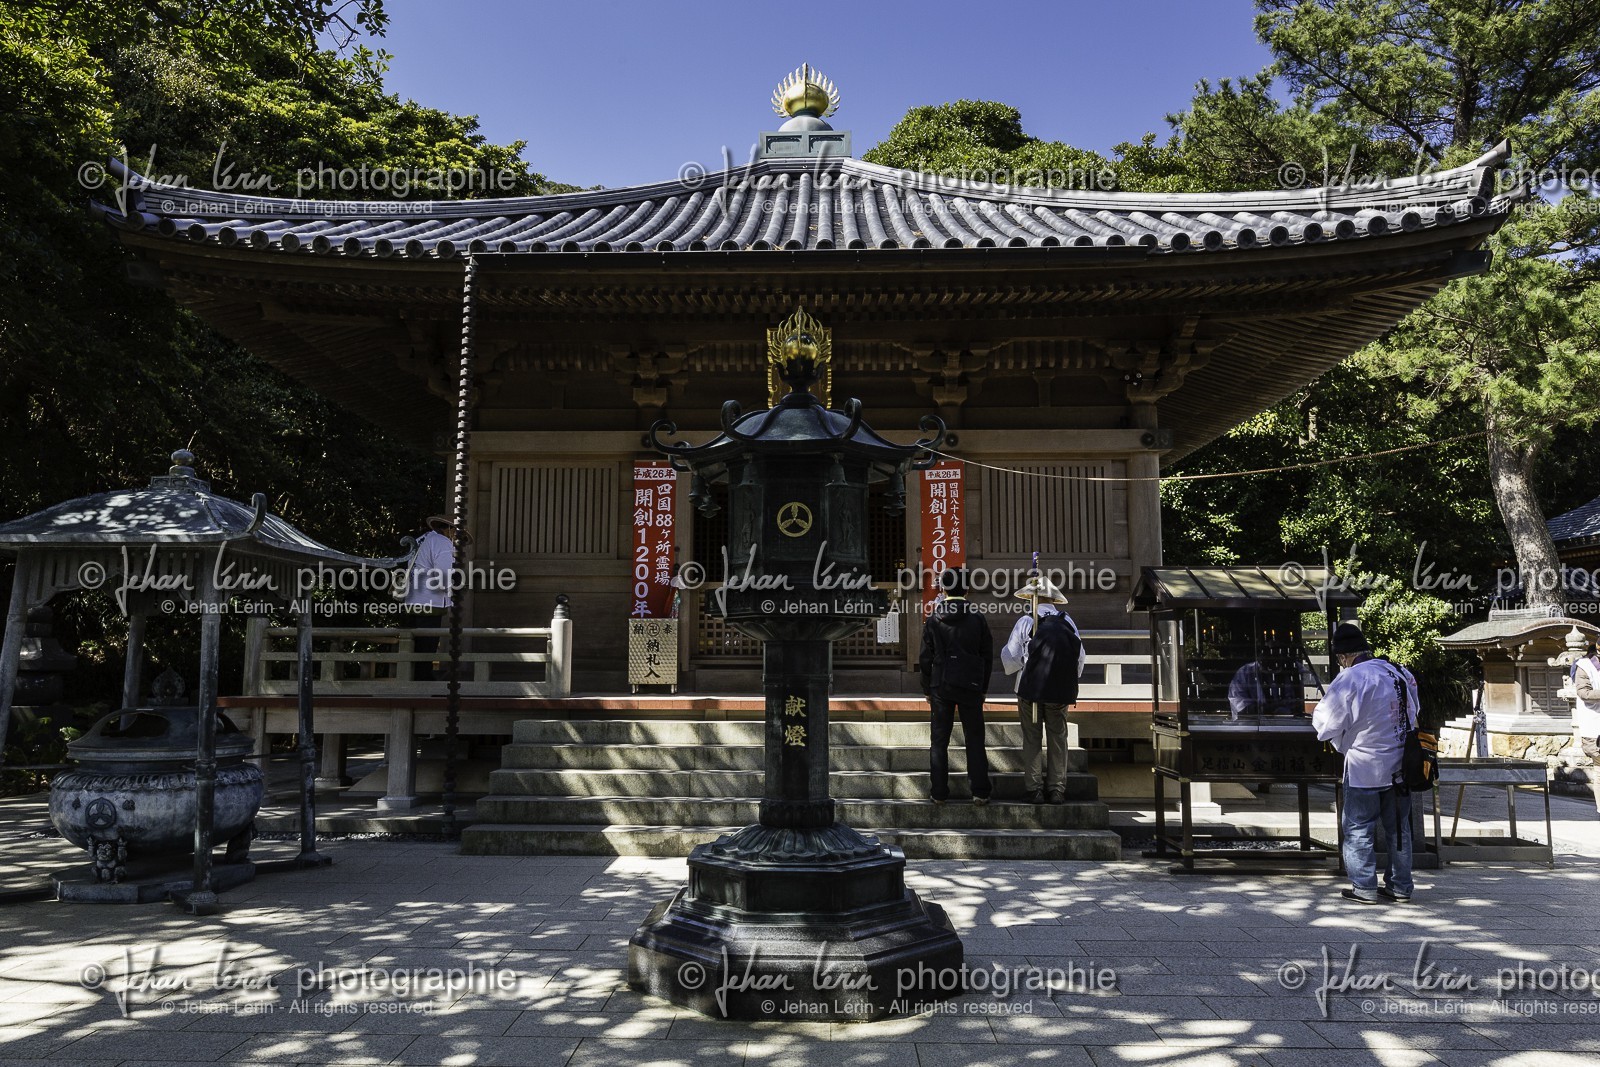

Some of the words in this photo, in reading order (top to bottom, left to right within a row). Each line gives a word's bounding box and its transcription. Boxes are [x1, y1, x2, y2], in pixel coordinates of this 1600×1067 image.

[634, 468, 675, 479] 平成26年
[927, 470, 958, 479] 平成26年
[631, 488, 653, 618] 開創1200年
[644, 638, 661, 678] 納札入
[784, 694, 807, 747] 献燈
